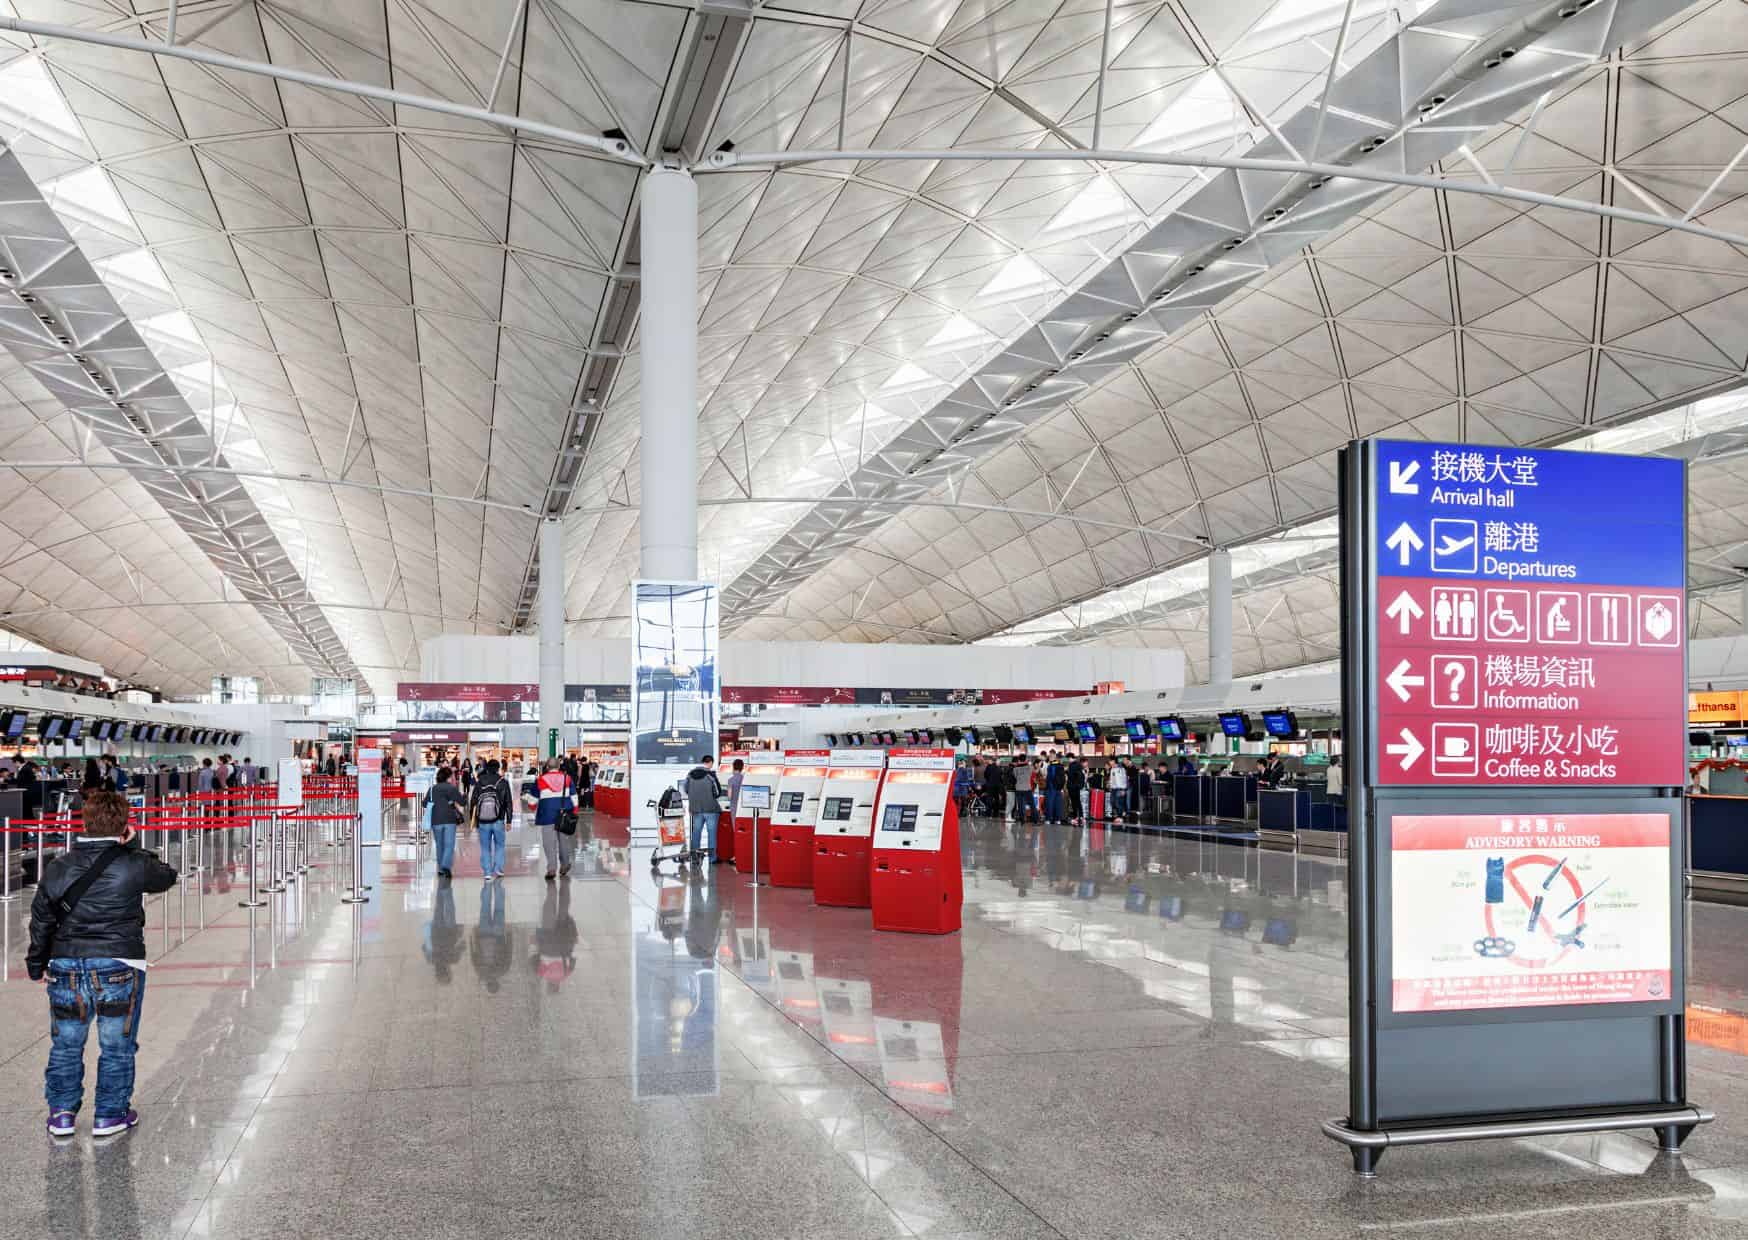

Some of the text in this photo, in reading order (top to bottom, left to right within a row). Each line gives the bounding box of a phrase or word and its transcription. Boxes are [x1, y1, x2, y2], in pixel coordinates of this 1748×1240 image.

[1431, 450, 1539, 486] 接機大堂
[1430, 487, 1514, 508] Arrival hall
[1484, 520, 1540, 553] 離港
[1484, 556, 1577, 581] Departures
[1484, 654, 1596, 689] 機場資訊
[1484, 690, 1579, 710] Information
[1485, 723, 1619, 757] 咖啡及小吃
[1484, 757, 1617, 778] Coffee & Snacks
[1465, 835, 1601, 849] ADVISORY WARNING
